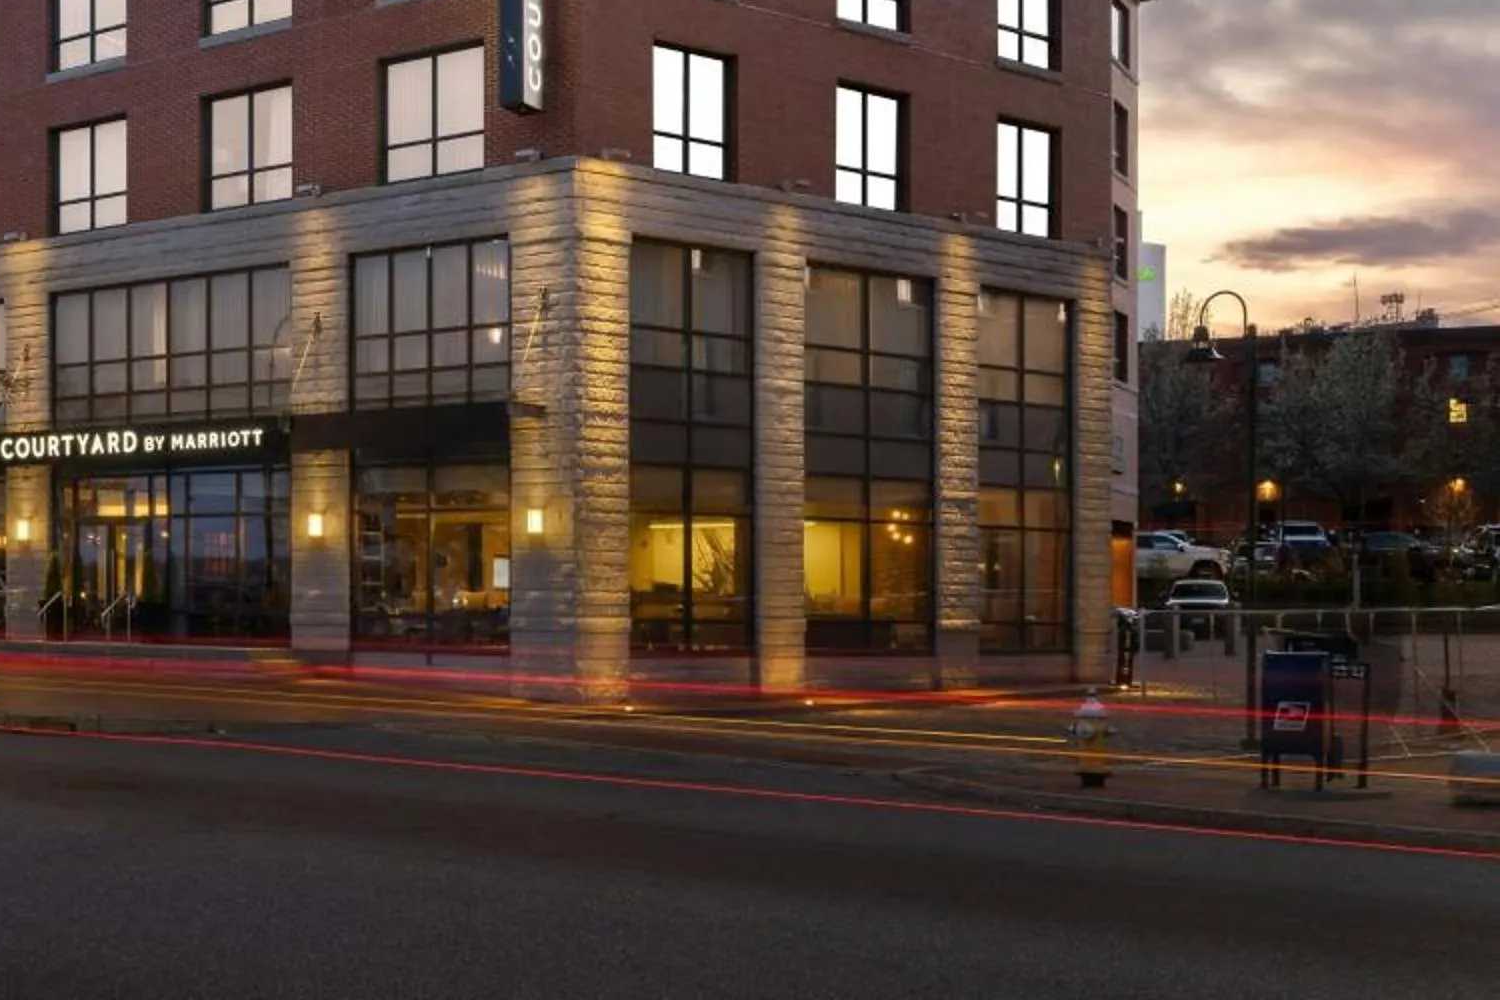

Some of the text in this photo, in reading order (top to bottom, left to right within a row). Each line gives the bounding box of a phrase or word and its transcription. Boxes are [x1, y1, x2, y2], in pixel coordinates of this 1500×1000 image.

[0, 429, 263, 460] COURTYARD BY MARRIOTT
